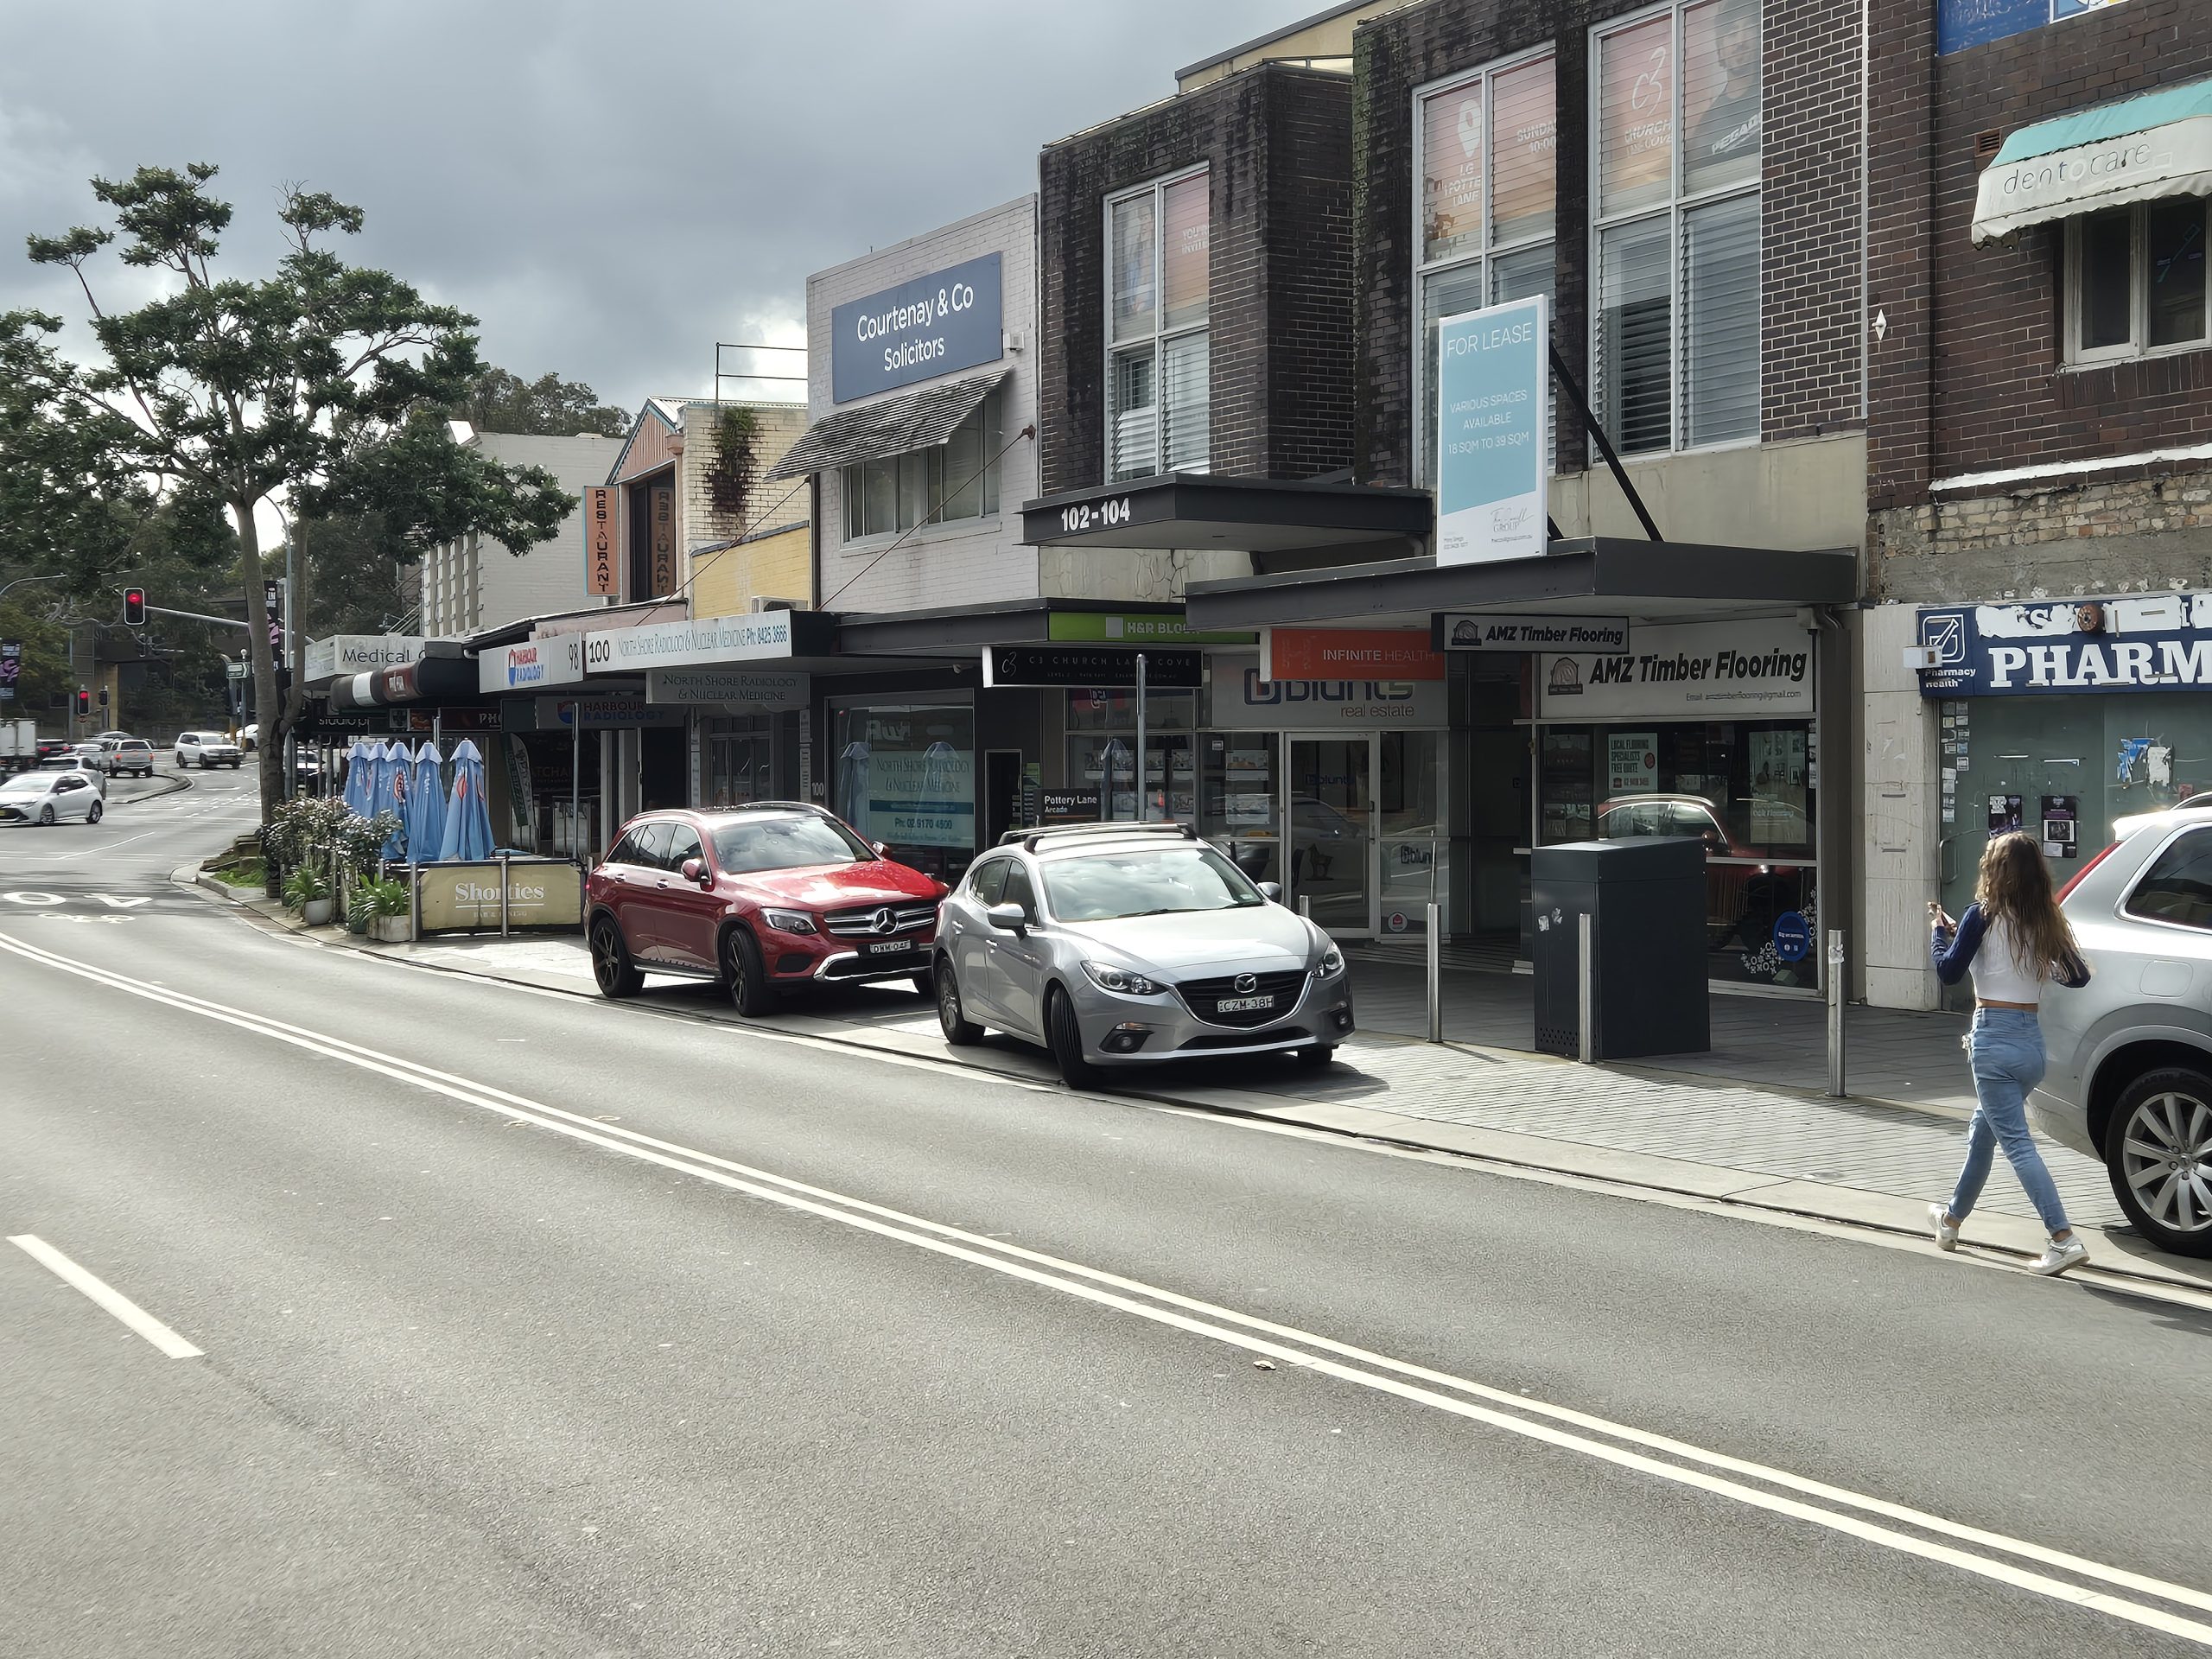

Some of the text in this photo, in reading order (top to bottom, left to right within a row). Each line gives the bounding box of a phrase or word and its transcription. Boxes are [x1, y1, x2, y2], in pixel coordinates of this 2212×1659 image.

[857, 283, 974, 342] Courtenay & Co
[1446, 322, 1532, 359] FOR LEASE
[884, 336, 944, 372] Solicitors
[1450, 389, 1528, 413] VARIOUS SPACES
[1463, 411, 1512, 430] AVAILABLE
[1448, 443, 1458, 454] 18
[1459, 441, 1479, 454] SQM
[1481, 438, 1493, 449] TO
[1507, 432, 1529, 447] SQM
[1061, 498, 1131, 531] 102-104
[595, 489, 609, 592] RESTAURANT
[1485, 626, 1624, 645] AMZ Timber Flooring
[342, 648, 410, 663] Medical
[569, 643, 579, 671] 98
[589, 639, 610, 663] 100
[1323, 649, 1435, 662] INFINITE HEALTH
[1052, 657, 1108, 665] CHURCH
[1157, 658, 1191, 667] COVE
[1589, 646, 1808, 684] AMZ Timber Flooring
[663, 674, 798, 688] NORTH SHORE RADIOLOGY
[1924, 667, 1976, 678] Pharmacy
[678, 689, 785, 702] & NUCLEAR MEDICINE
[583, 702, 645, 712] HARBOUR
[583, 711, 664, 721] RADIOLOGY
[1340, 704, 1414, 718] real estate
[1044, 795, 1097, 806] Pottery Lane
